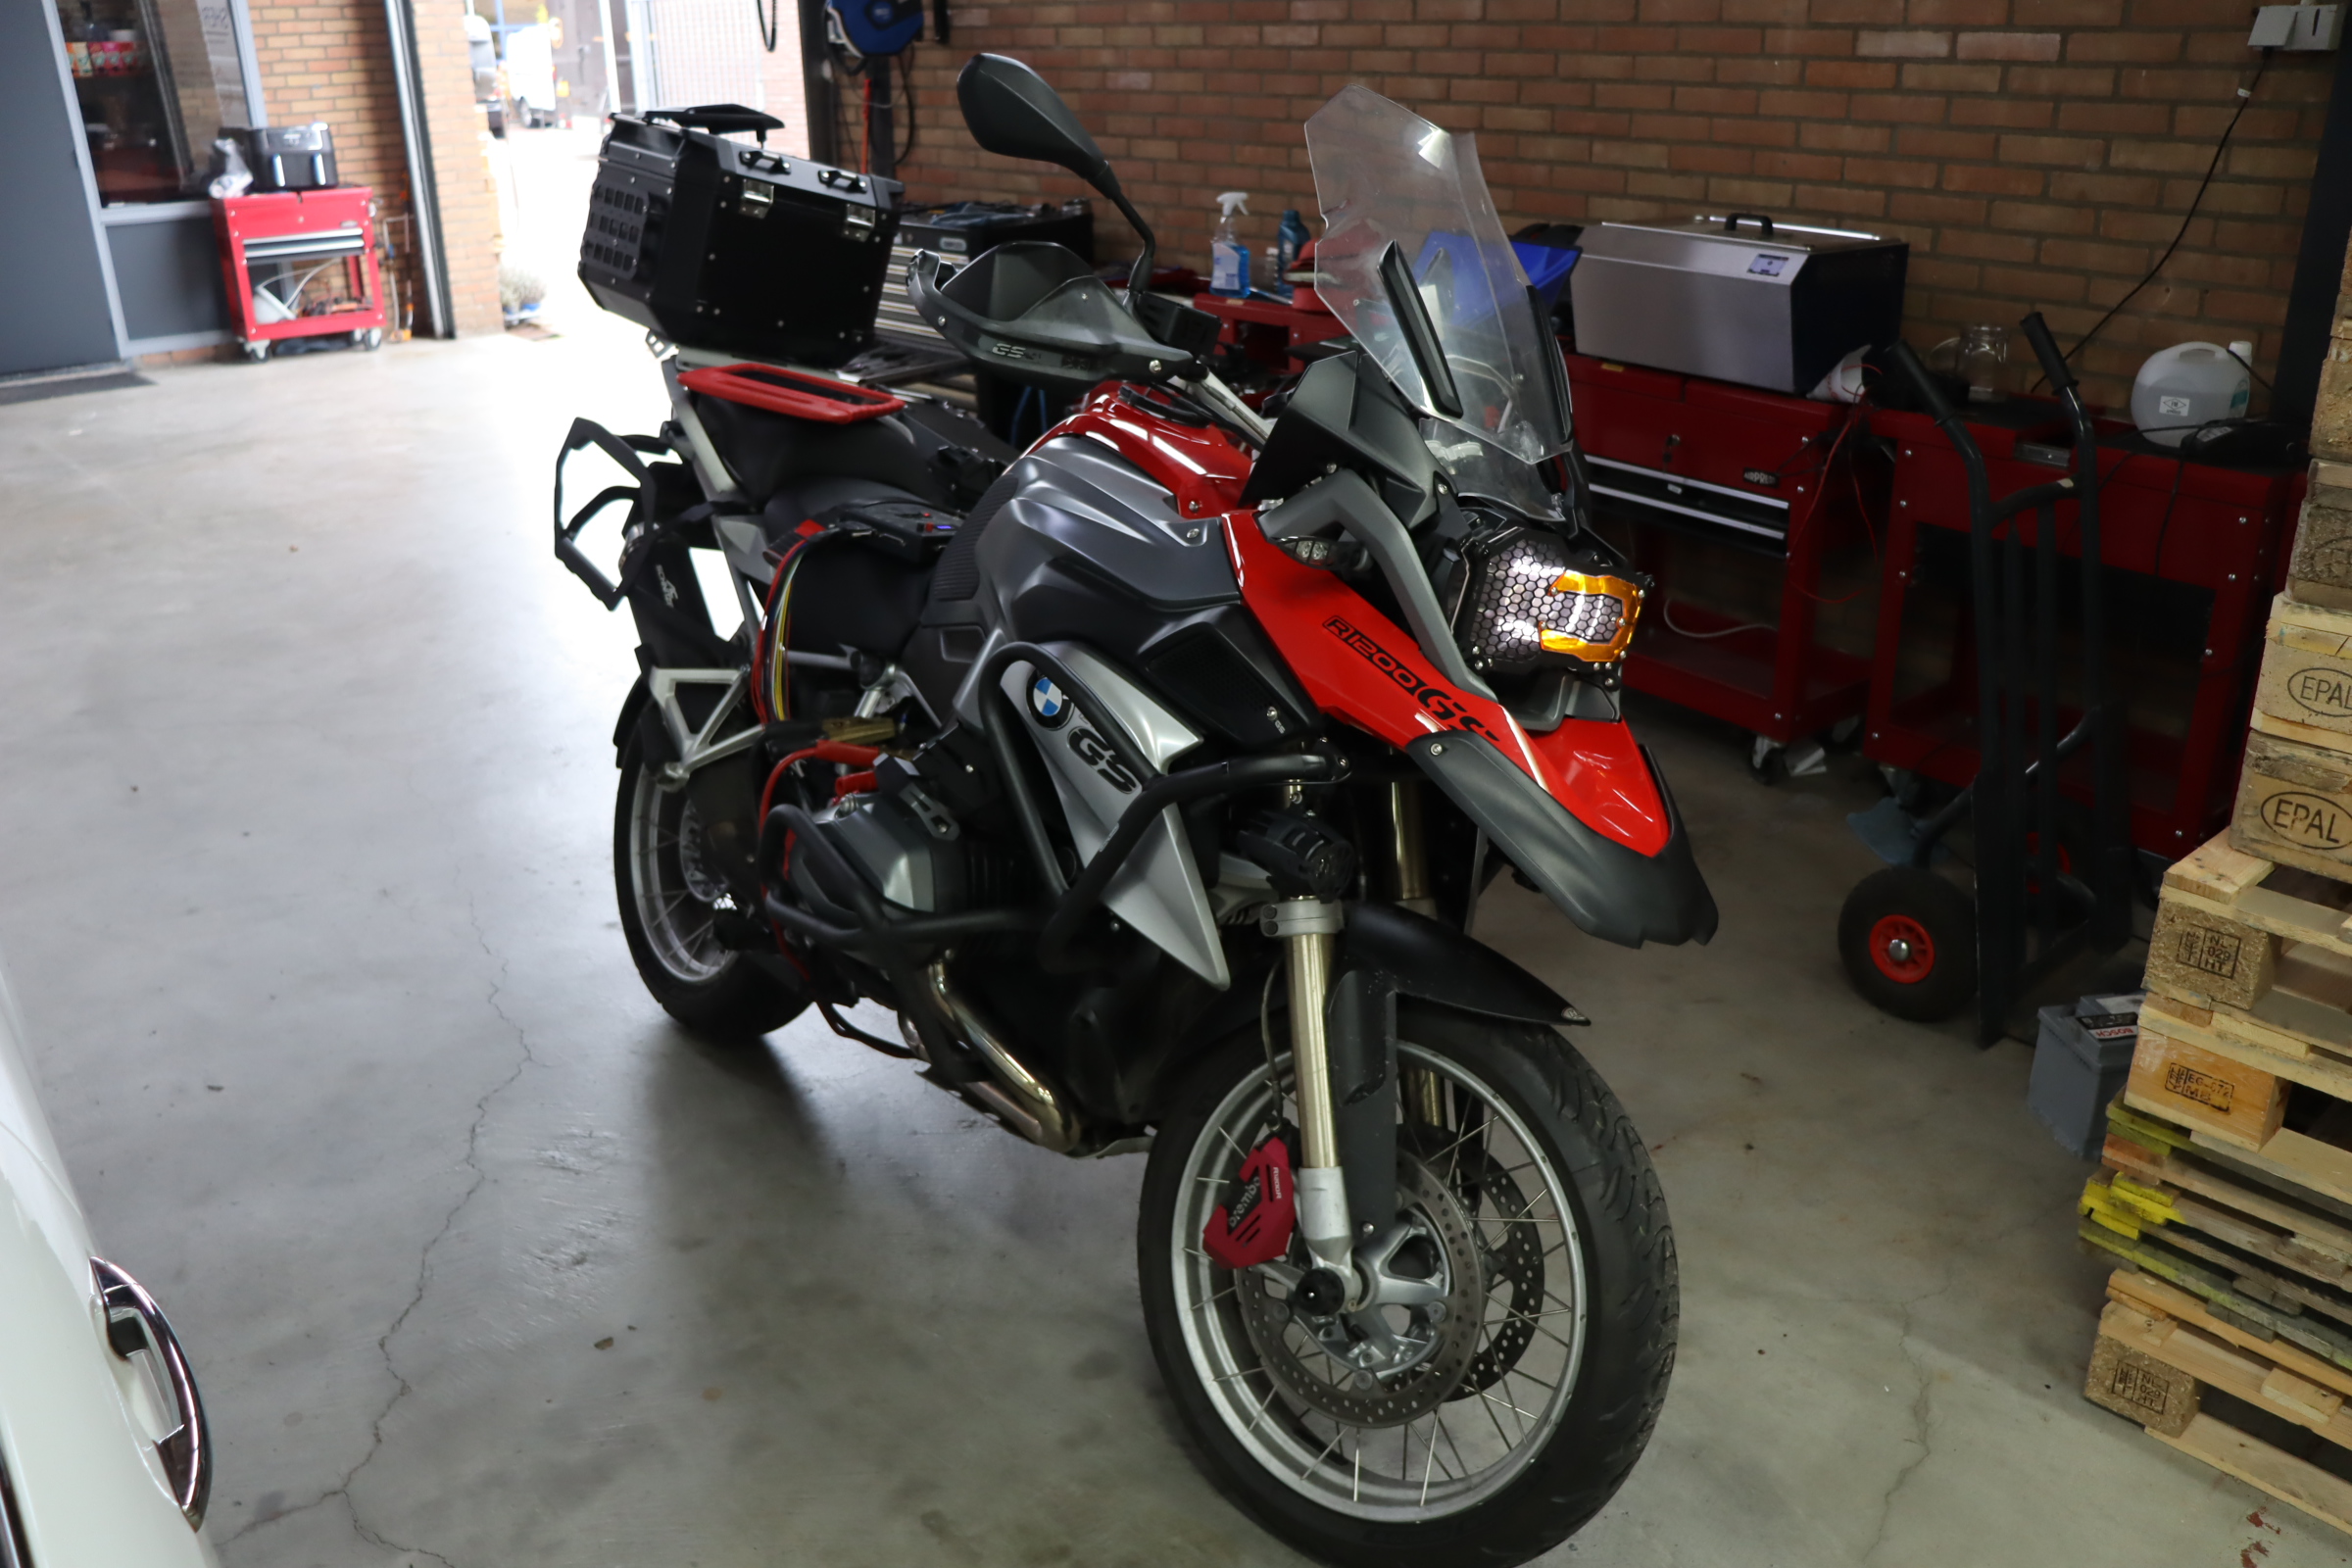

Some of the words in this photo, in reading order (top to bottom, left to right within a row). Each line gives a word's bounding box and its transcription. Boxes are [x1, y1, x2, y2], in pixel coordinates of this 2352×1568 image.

[993, 343, 1026, 359] GS
[1067, 727, 1137, 793] GS
[2273, 798, 2340, 844] EPAL
[2207, 946, 2230, 961] 029
[2204, 958, 2226, 971] HT
[2095, 1027, 2134, 1038] BOSCH
[2139, 1384, 2161, 1399] 029
